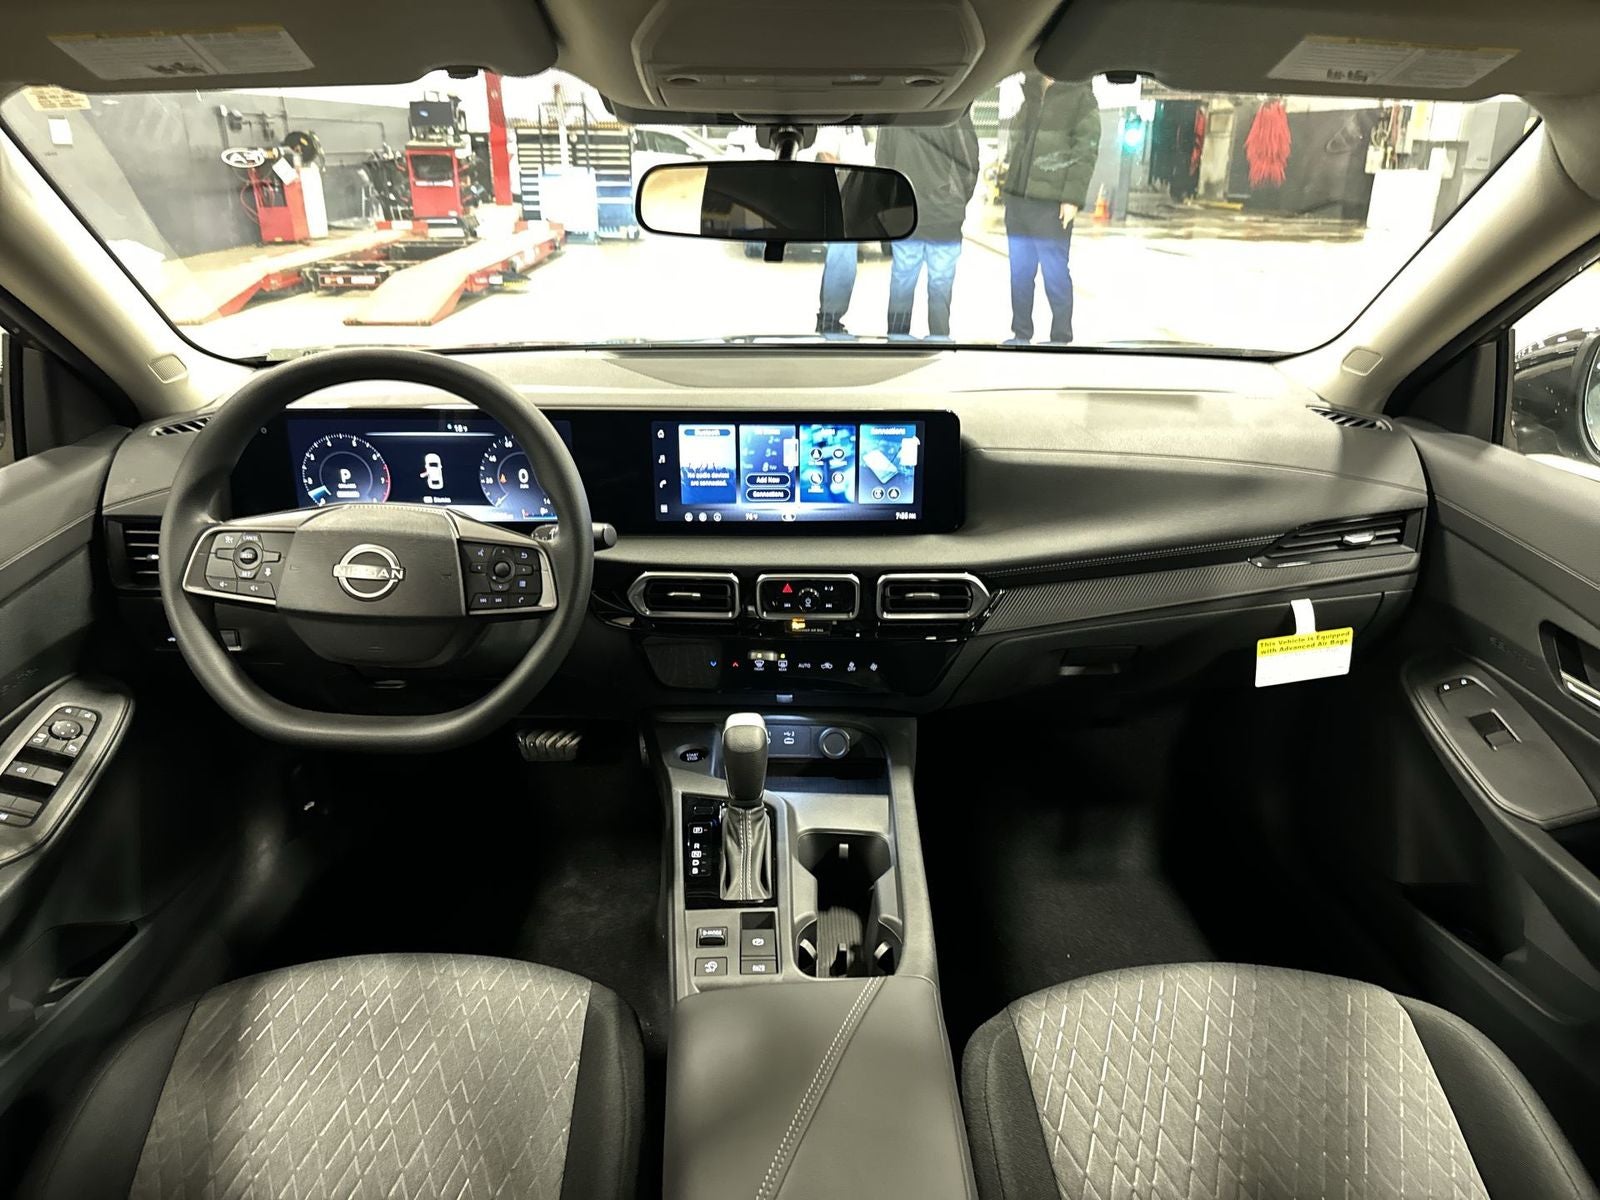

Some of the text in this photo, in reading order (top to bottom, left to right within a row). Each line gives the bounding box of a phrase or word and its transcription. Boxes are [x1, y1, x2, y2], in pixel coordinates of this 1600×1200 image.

[339, 468, 352, 484] P
[518, 468, 529, 483] 0
[1260, 647, 1277, 655] with
[1279, 642, 1315, 653] Advanced
[1330, 637, 1349, 647] Bags
[1278, 637, 1305, 646] Vehicle
[1316, 631, 1351, 641] Equipped
